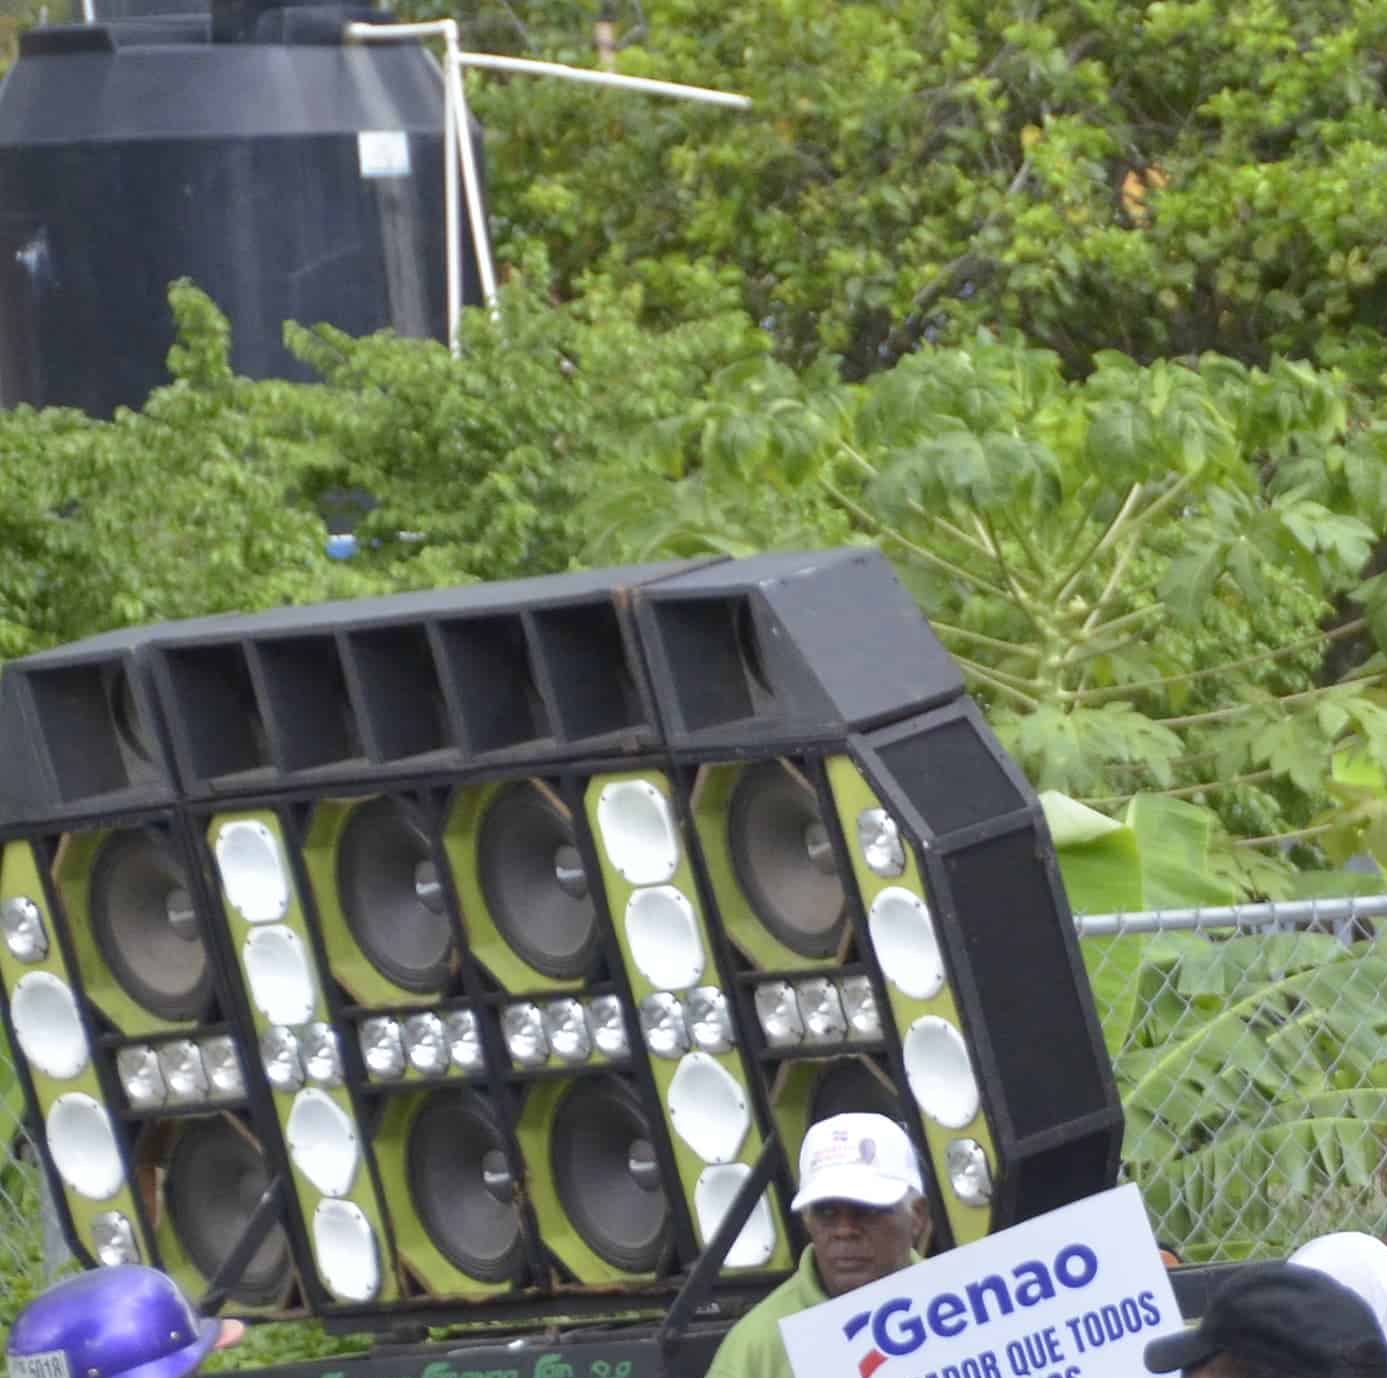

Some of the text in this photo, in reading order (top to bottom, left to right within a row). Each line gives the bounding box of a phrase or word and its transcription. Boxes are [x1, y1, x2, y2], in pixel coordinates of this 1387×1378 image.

[872, 1242, 1099, 1357] Genao
[1007, 1326, 1064, 1378] QUE
[1065, 1291, 1162, 1353] TODOS
